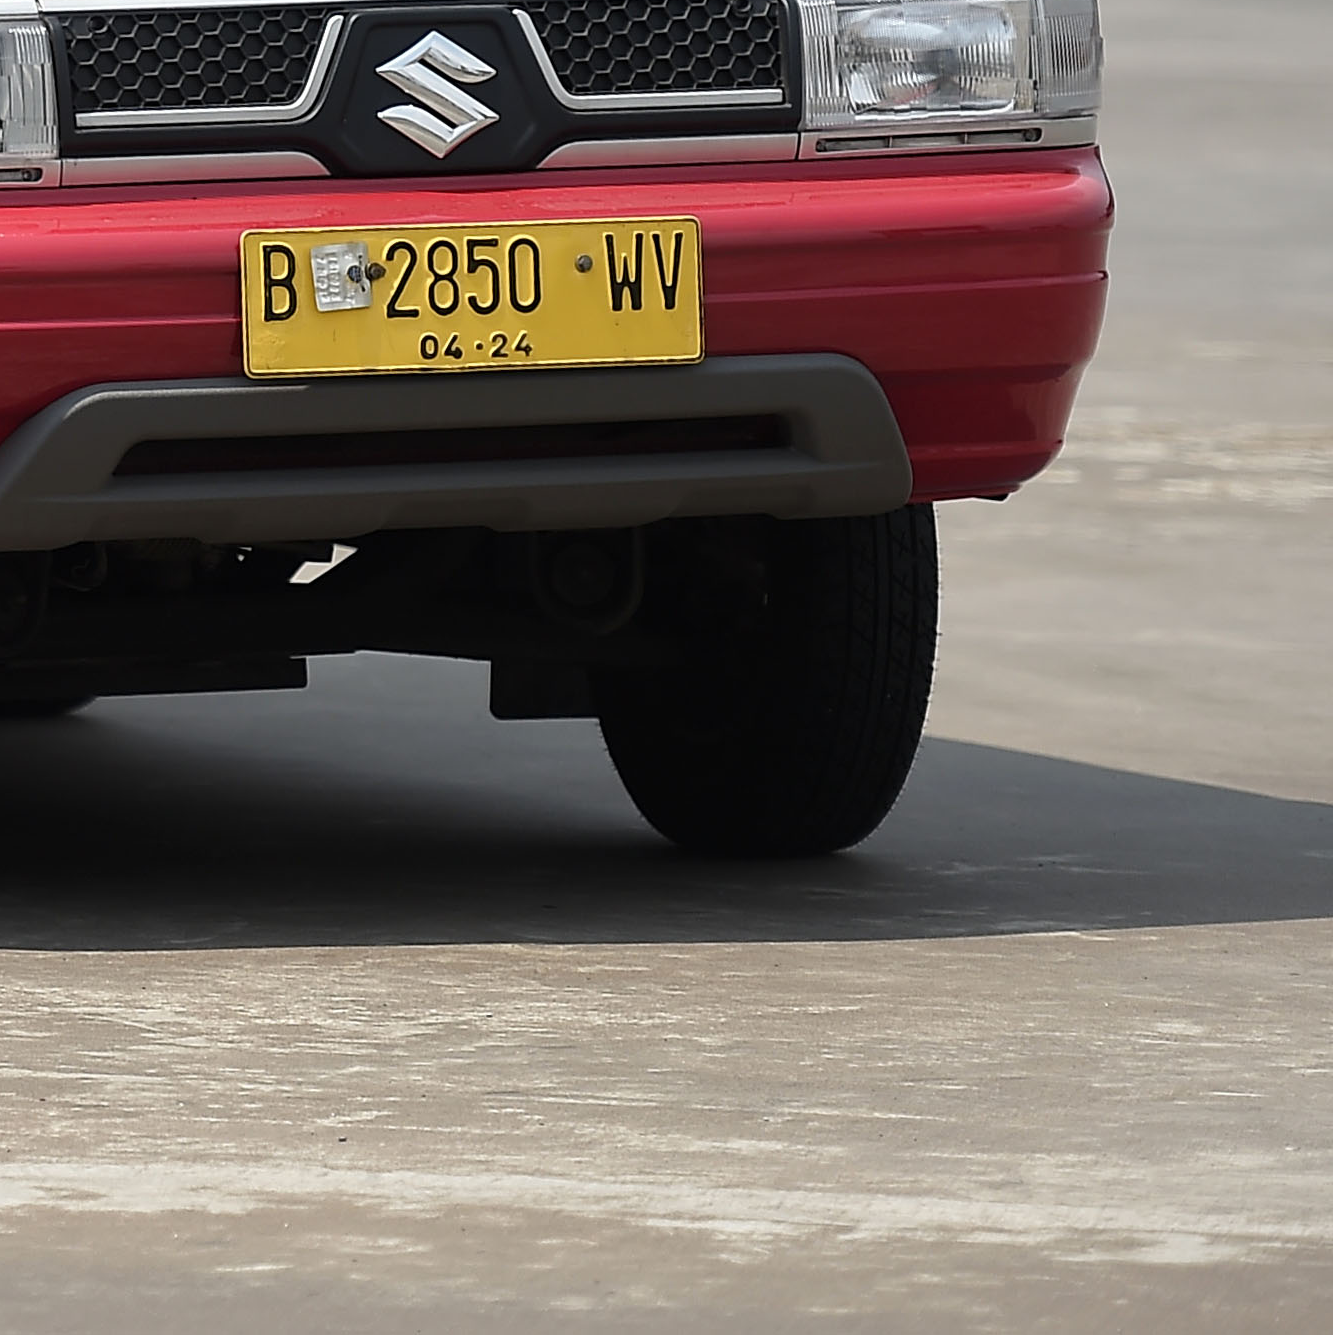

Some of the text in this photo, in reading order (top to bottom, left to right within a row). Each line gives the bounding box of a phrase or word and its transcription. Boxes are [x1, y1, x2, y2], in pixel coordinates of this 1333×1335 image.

[261, 241, 298, 322] B
[384, 233, 542, 319] 2850
[602, 230, 685, 313] WV
